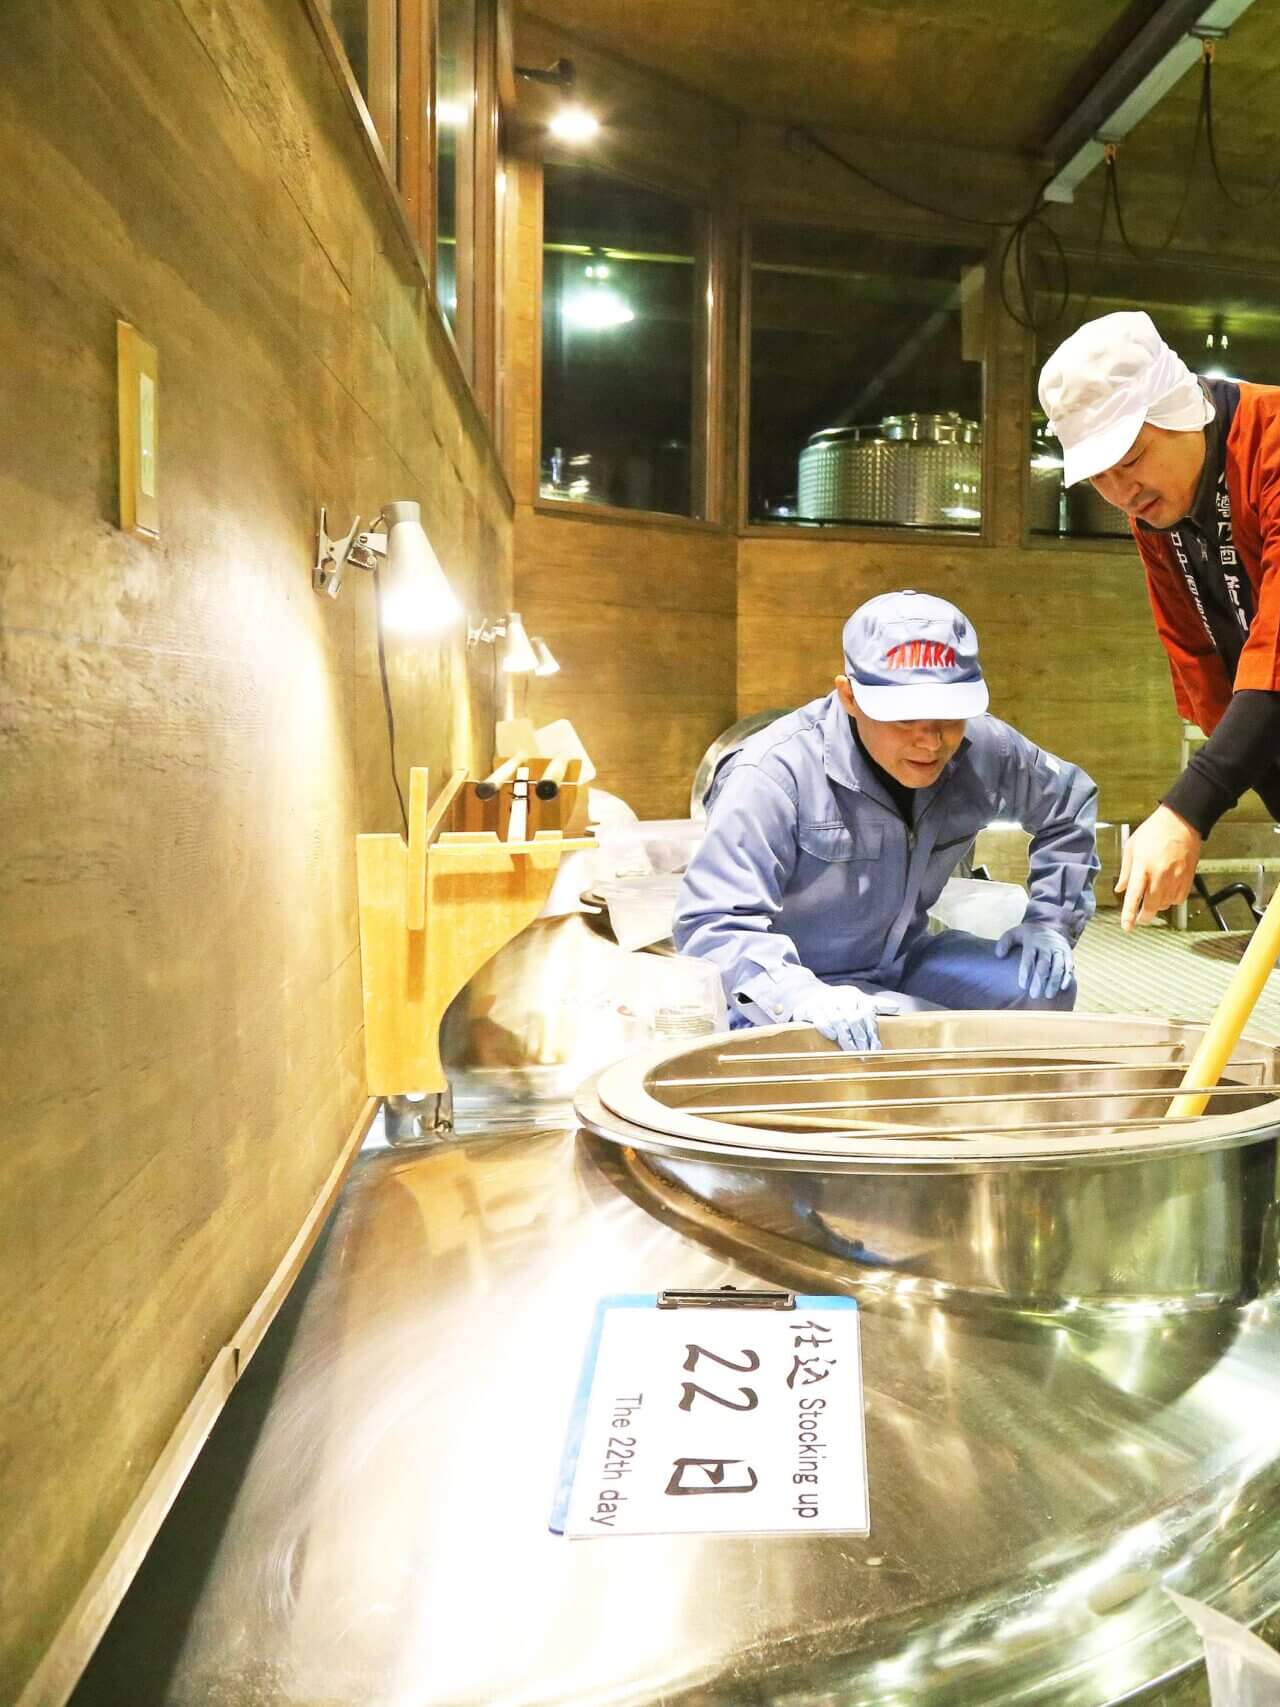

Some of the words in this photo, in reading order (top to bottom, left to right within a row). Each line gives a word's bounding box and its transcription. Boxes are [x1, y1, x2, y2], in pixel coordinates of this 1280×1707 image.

[886, 638, 956, 672] TANAKA
[786, 1320, 836, 1389] 仕込
[611, 1393, 643, 1429] The
[602, 1437, 636, 1481] 22th
[792, 1397, 826, 1485] Stocking
[590, 1489, 628, 1527] day
[792, 1494, 818, 1519] up
